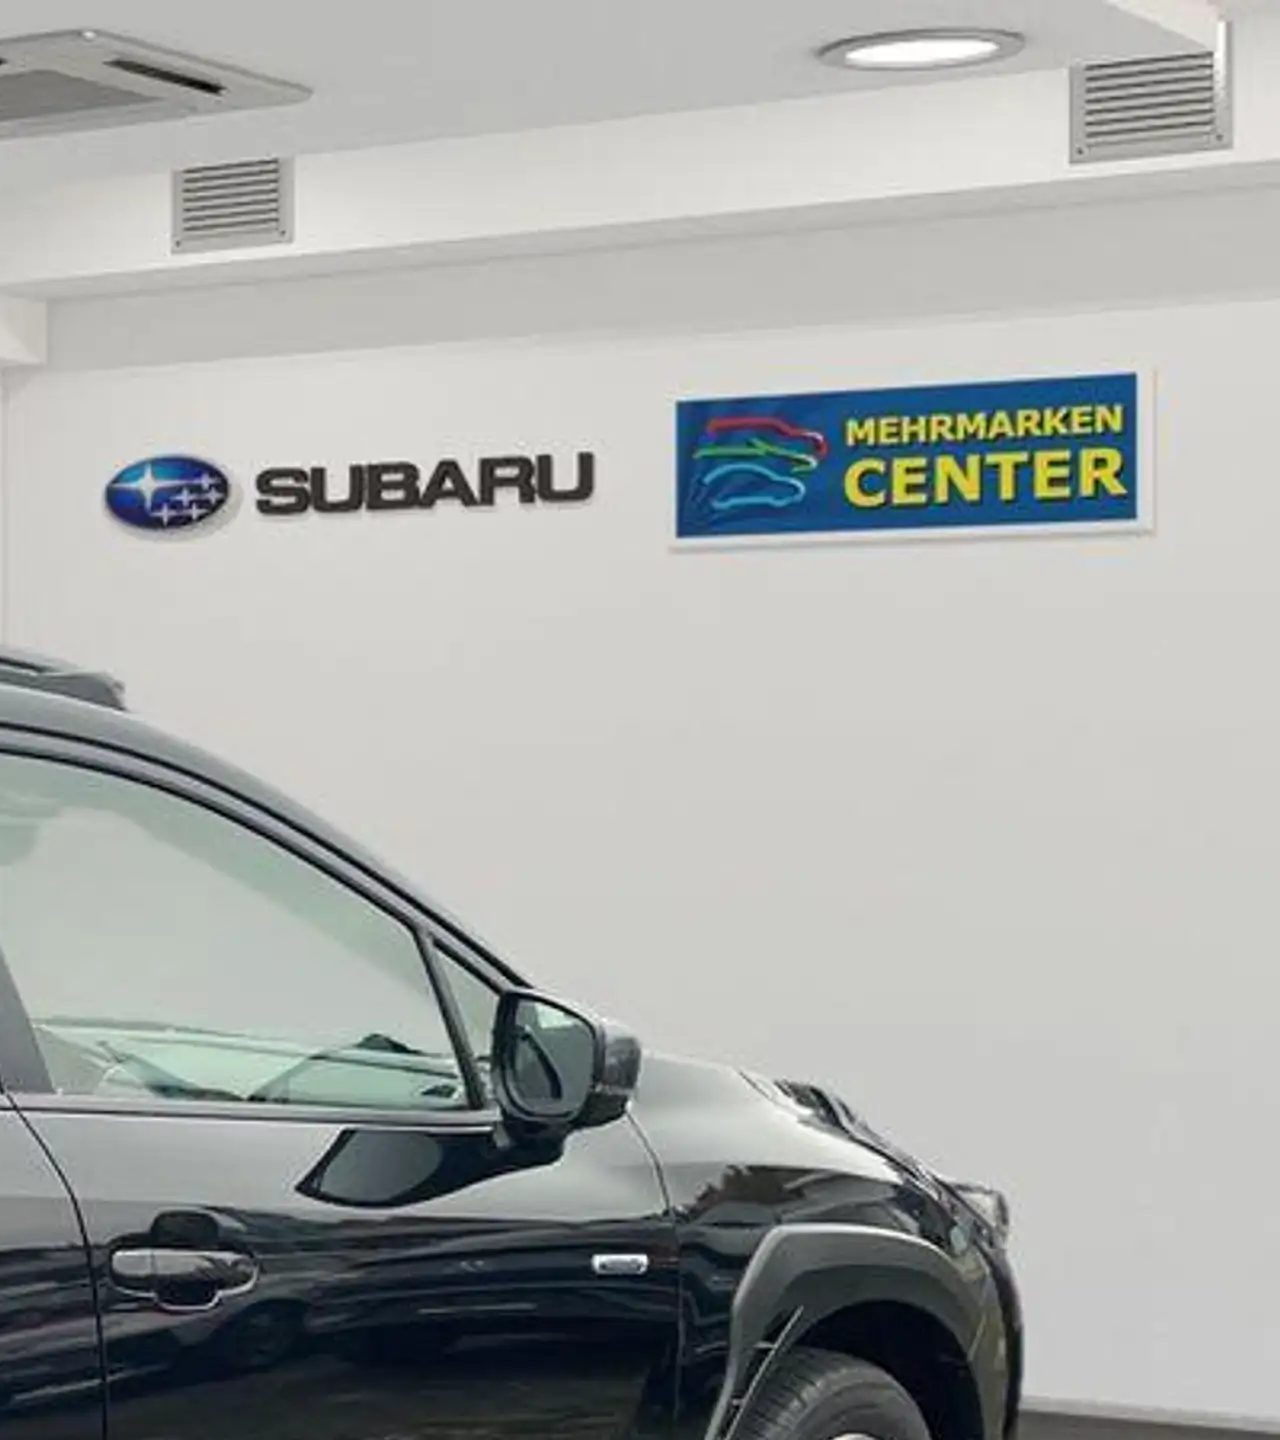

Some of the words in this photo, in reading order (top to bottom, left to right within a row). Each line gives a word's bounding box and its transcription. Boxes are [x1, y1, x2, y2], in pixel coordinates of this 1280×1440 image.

[845, 404, 1124, 446] MEHRMARKEN
[255, 451, 595, 516] SUBARU
[843, 446, 1128, 508] CENTER
